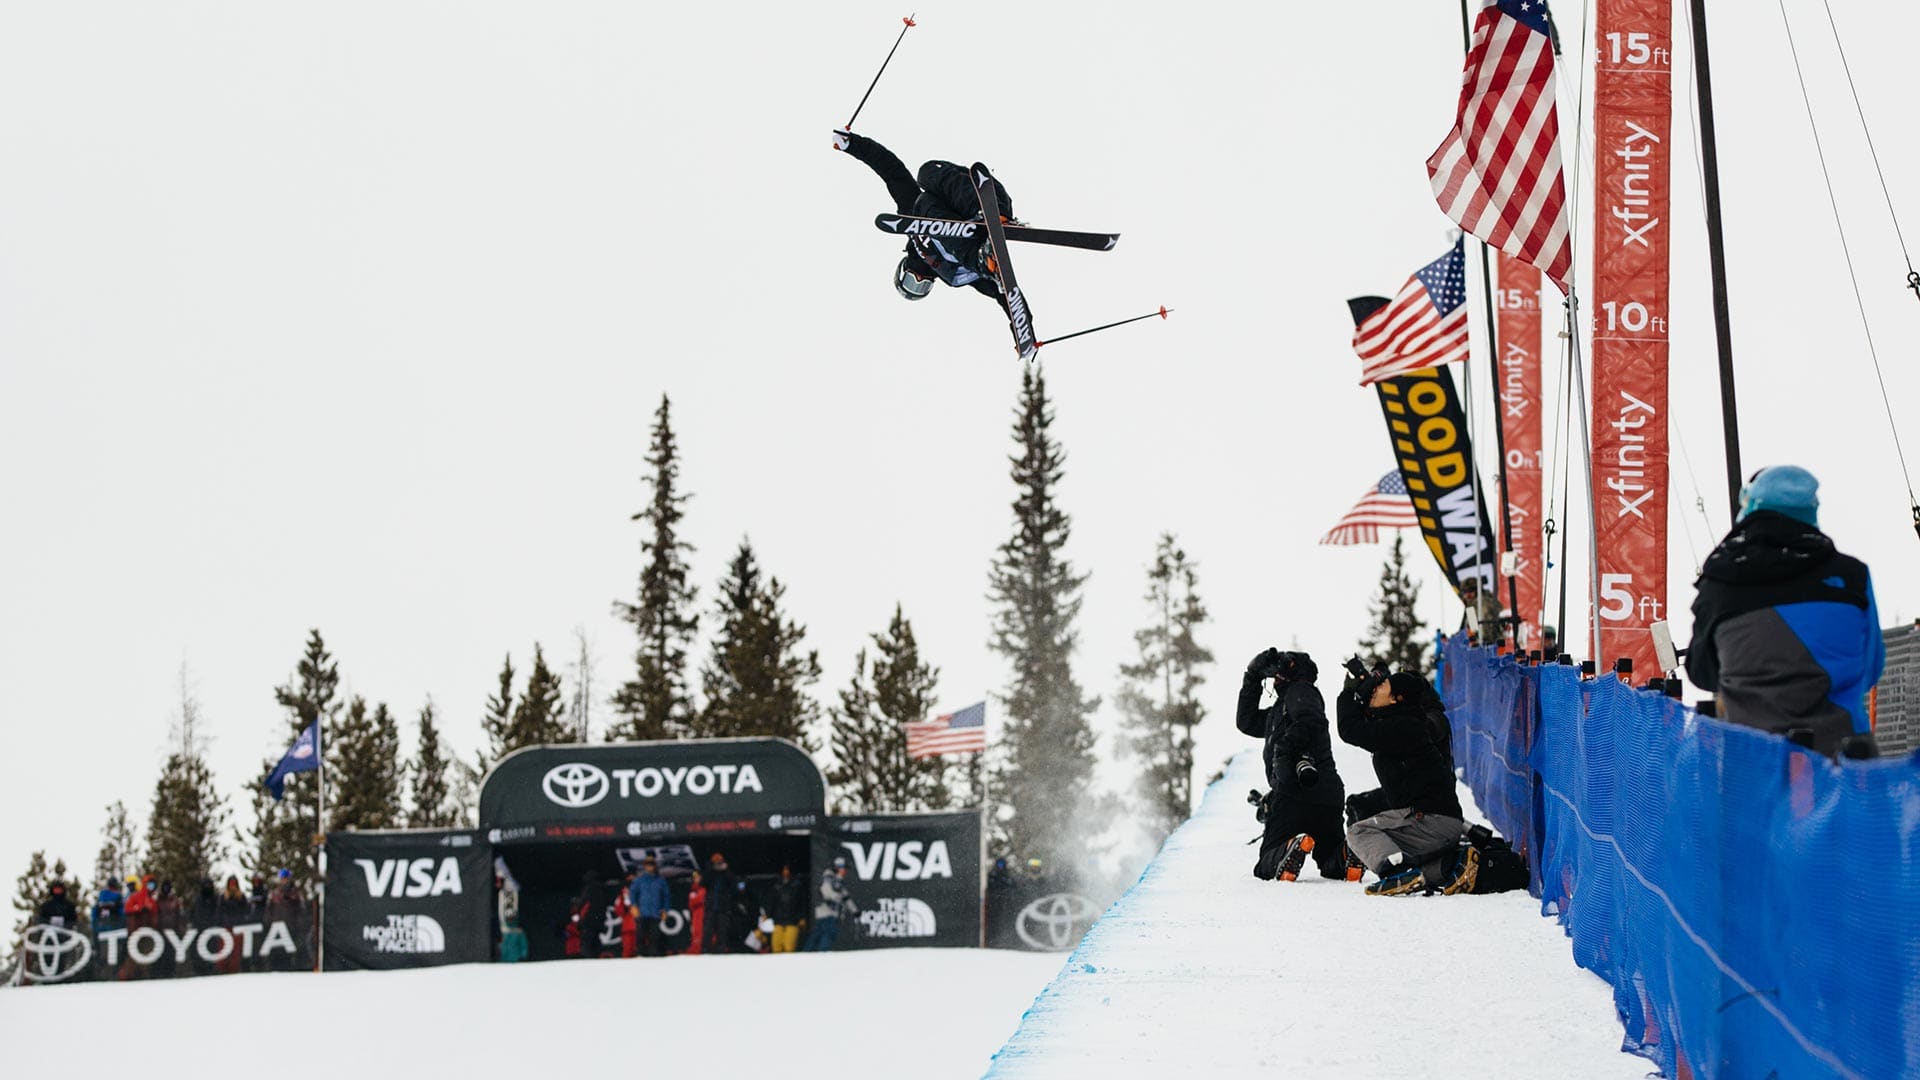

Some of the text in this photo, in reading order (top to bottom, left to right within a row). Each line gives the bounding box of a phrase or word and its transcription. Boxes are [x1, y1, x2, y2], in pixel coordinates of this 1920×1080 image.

[1612, 120, 1660, 247] xfinity
[905, 220, 977, 238] ATOMIC
[1008, 287, 1031, 344] ATOMIC
[1501, 342, 1529, 418] xfinity
[1607, 391, 1656, 519] xfinity
[612, 764, 763, 799] TOYOTA
[354, 856, 463, 898] VISA
[841, 840, 953, 881] VISA
[387, 914, 416, 928] THE
[878, 898, 908, 912] THE
[99, 921, 297, 965] TOYOTA
[363, 926, 416, 941] NORTH
[377, 940, 416, 953] FACE
